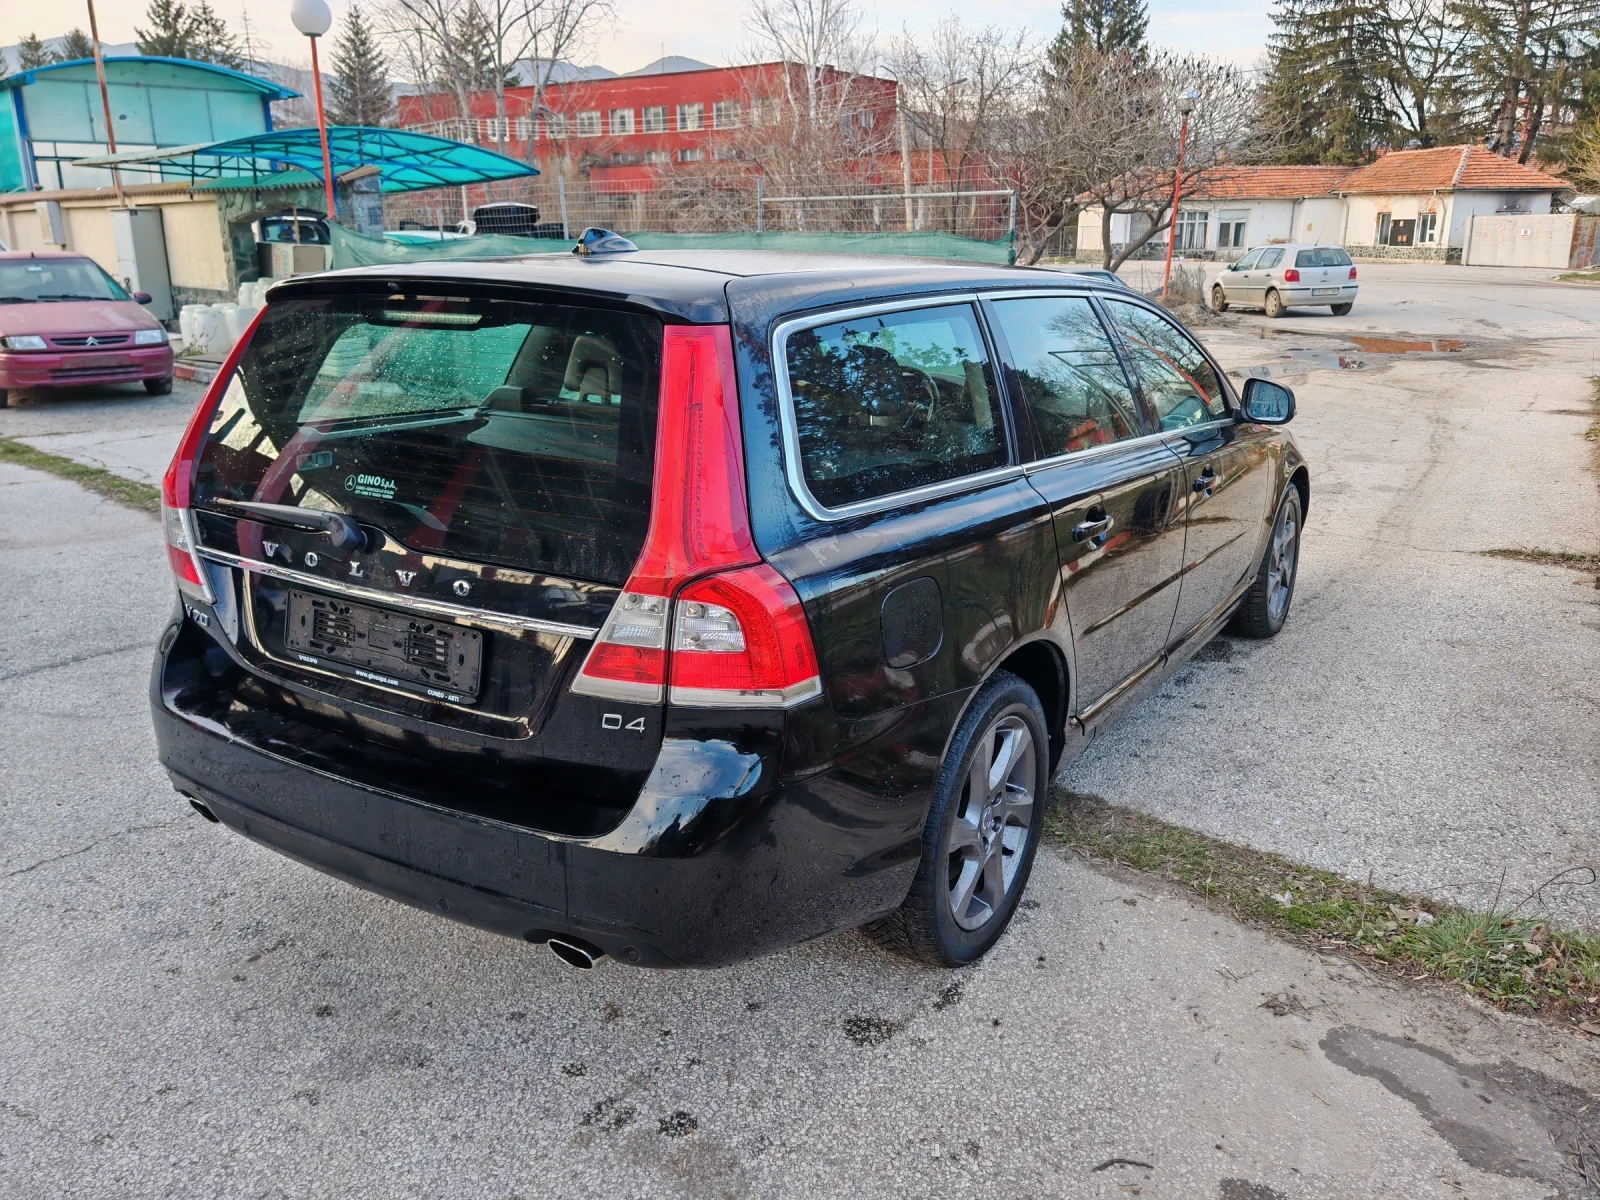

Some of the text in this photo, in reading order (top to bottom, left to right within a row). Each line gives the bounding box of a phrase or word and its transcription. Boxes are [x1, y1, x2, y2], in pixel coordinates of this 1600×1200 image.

[357, 474, 381, 486] GINO
[262, 540, 471, 597] VOLVO
[185, 603, 210, 627] V70
[298, 654, 318, 664] VOLVO
[356, 670, 398, 686] www.ginospa.com
[427, 689, 444, 698] CUNEO
[601, 713, 646, 733] D4
